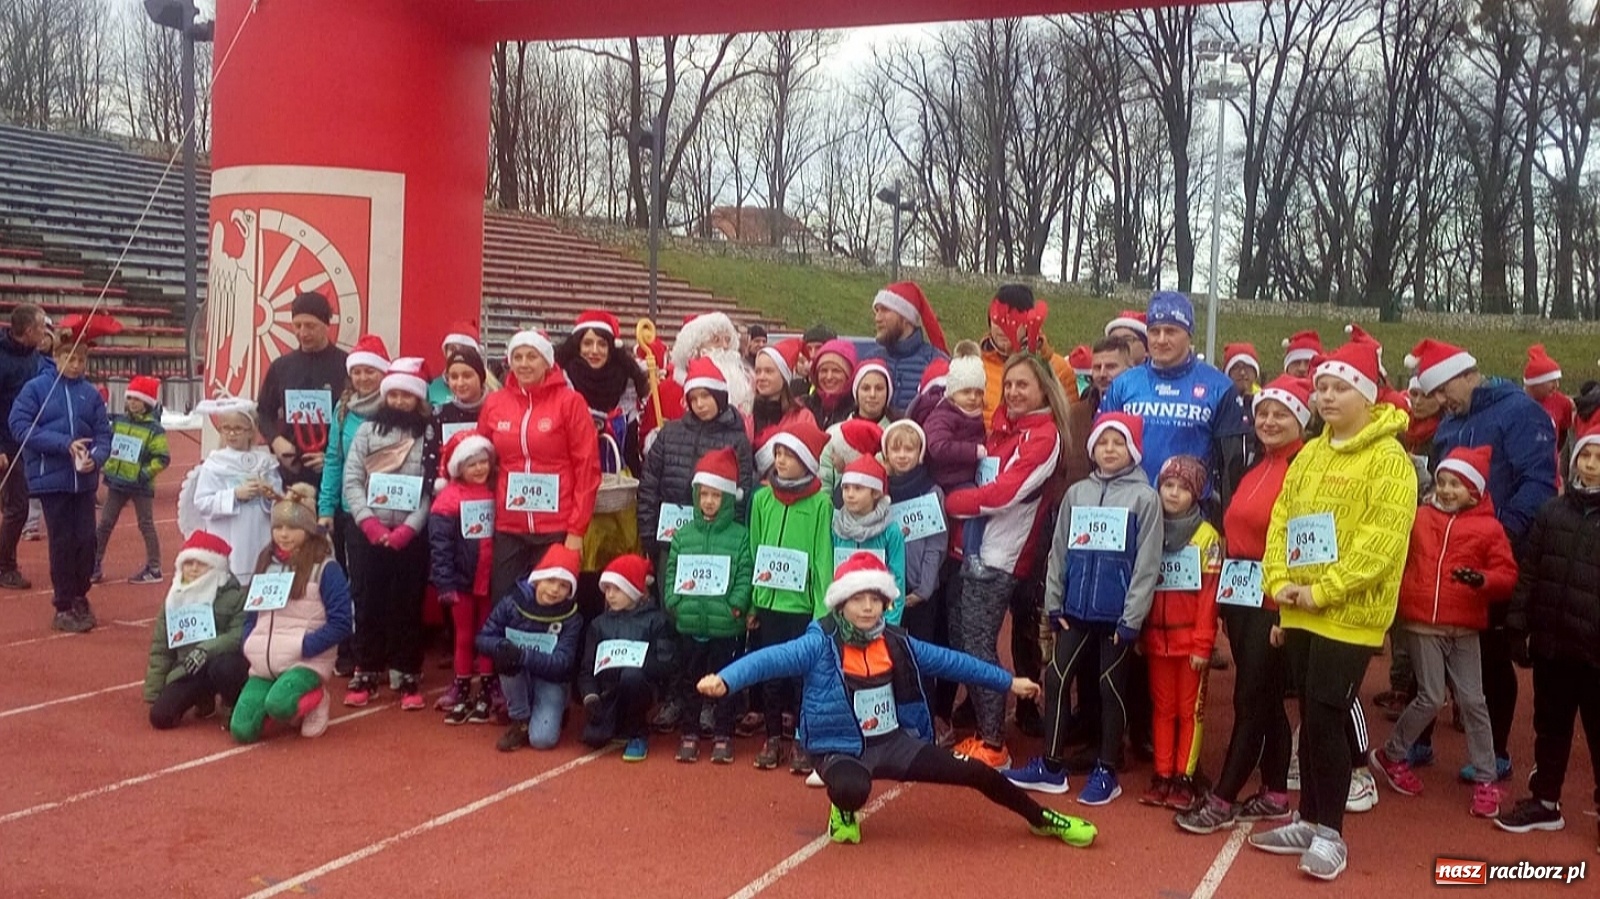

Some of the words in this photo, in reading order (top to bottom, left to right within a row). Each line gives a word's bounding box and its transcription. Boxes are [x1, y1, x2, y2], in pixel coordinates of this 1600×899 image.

[299, 401, 316, 411] 047
[1122, 401, 1211, 422] RUNNERS
[522, 485, 542, 497] 048
[903, 511, 924, 525] 005
[1296, 531, 1316, 545] 034
[769, 561, 789, 573] 030
[692, 568, 712, 579] 023
[262, 585, 279, 596] 052
[179, 617, 197, 628] 050
[610, 648, 628, 656] 100
